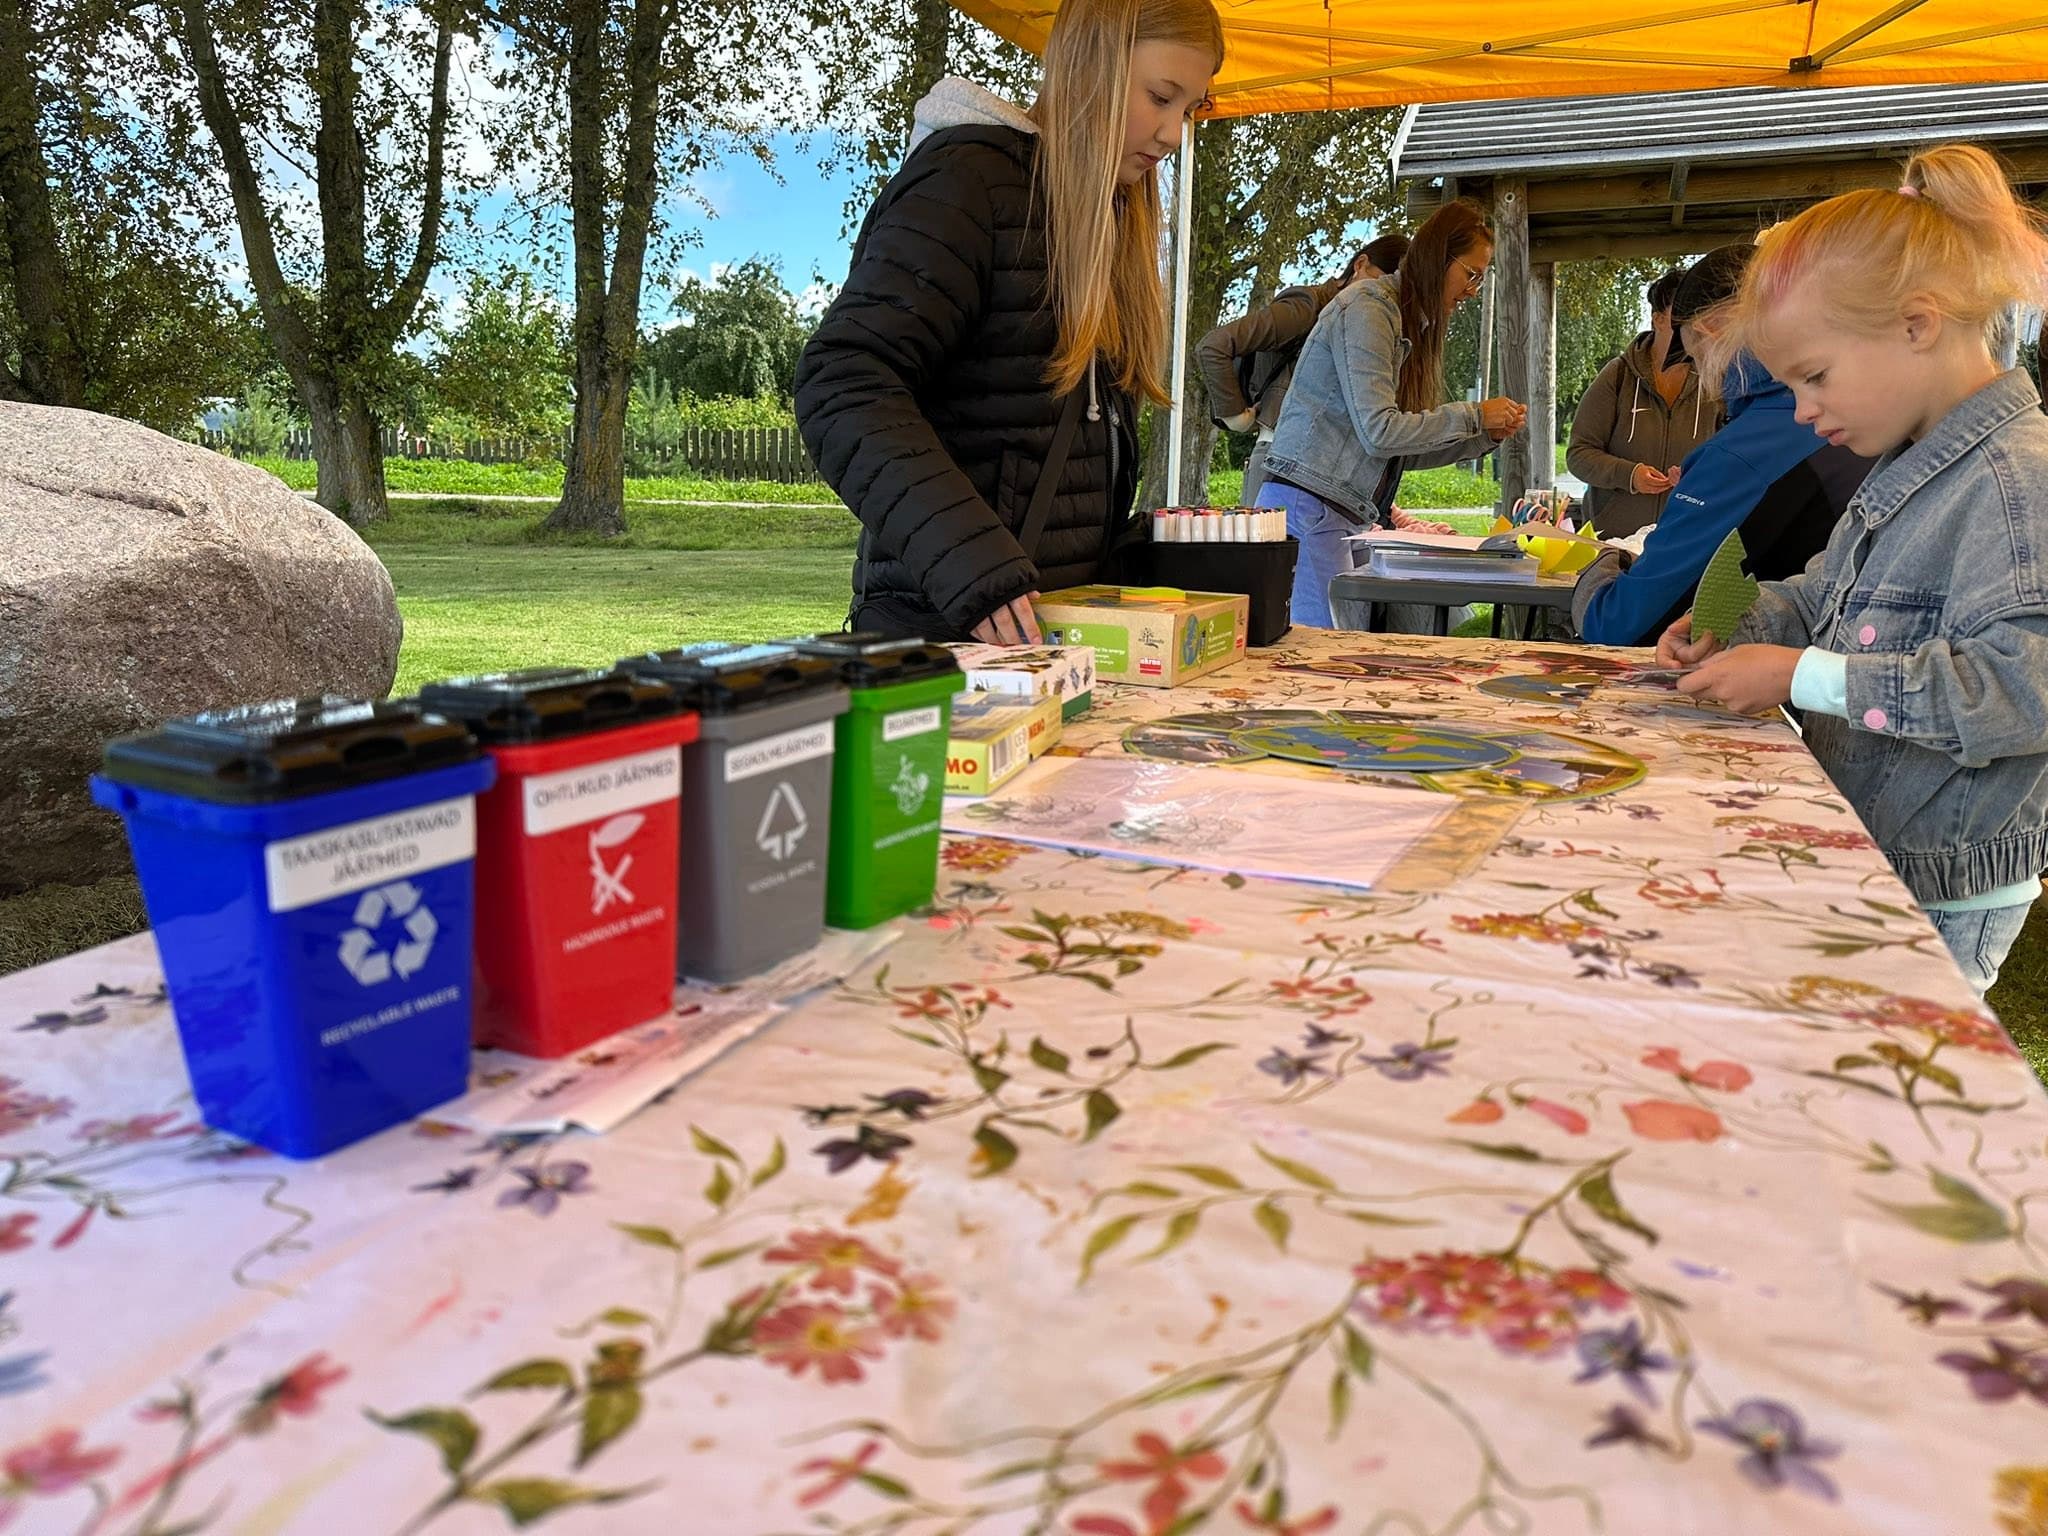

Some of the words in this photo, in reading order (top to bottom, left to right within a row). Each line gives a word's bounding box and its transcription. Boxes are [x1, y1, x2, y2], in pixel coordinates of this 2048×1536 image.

[533, 774, 613, 807] OHTLIKUD
[614, 757, 676, 789] JÄÄTMED
[944, 757, 978, 775] MO
[330, 842, 421, 886] JÄÄTMED
[320, 1001, 413, 1047] RECYCLABLE
[414, 985, 461, 1014] WASTE
